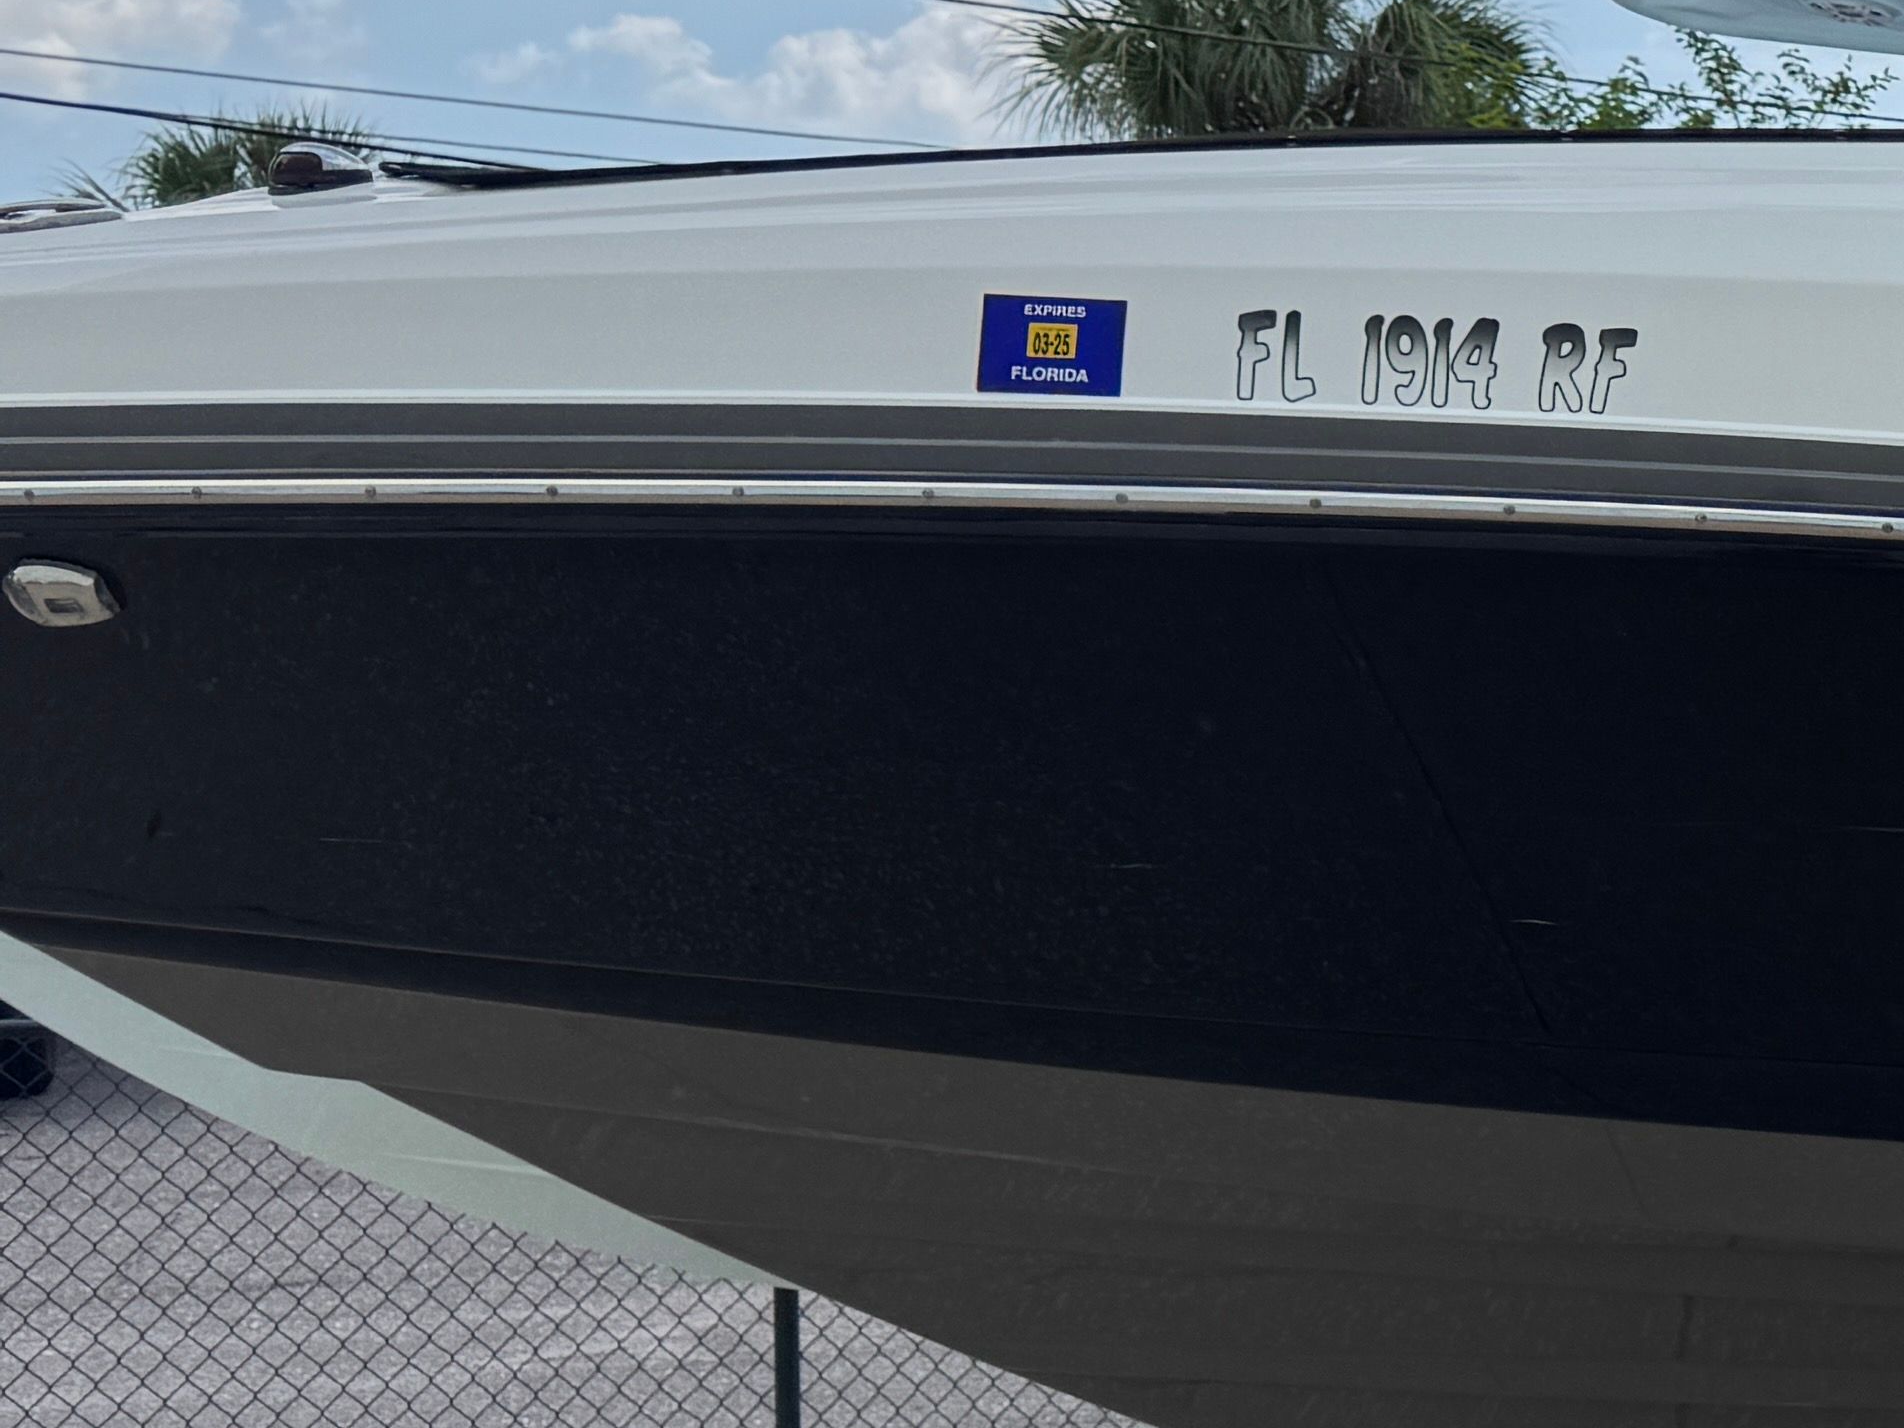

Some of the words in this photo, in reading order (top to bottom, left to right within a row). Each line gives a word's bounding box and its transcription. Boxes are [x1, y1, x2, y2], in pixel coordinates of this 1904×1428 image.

[1024, 304, 1087, 318] EXPIRES
[1033, 332, 1070, 356] 03-25
[1236, 309, 1316, 403] FL
[1361, 314, 1501, 410] 1914
[1538, 322, 1638, 414] RF
[1010, 365, 1089, 383] FLORIDA
